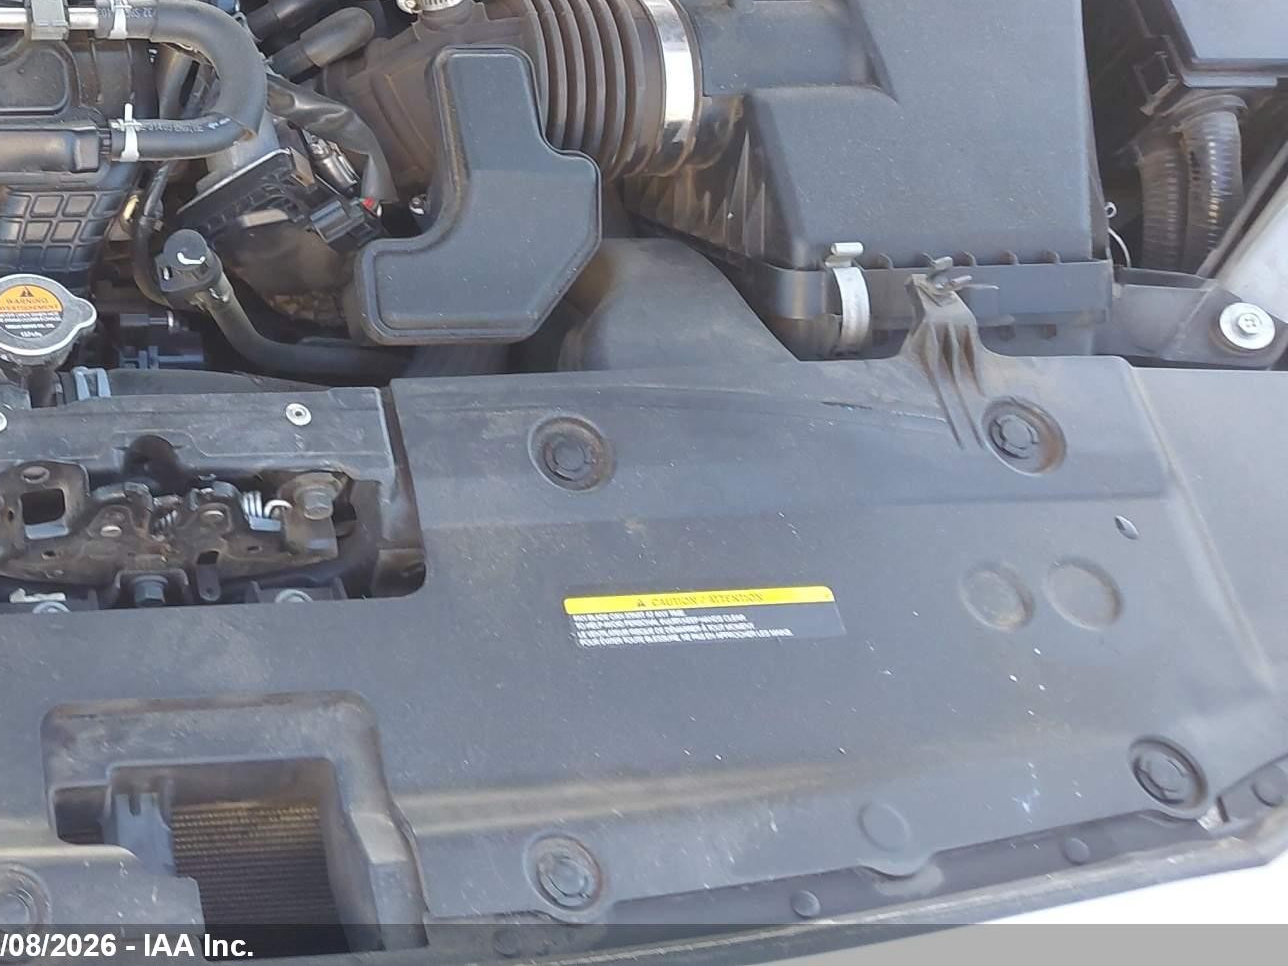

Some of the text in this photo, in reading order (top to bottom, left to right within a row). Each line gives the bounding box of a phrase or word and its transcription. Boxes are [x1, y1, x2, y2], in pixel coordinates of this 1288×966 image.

[6, 297, 48, 305] WARNING
[652, 595, 697, 607] CAUTION
[709, 592, 764, 604] ATTENTION
